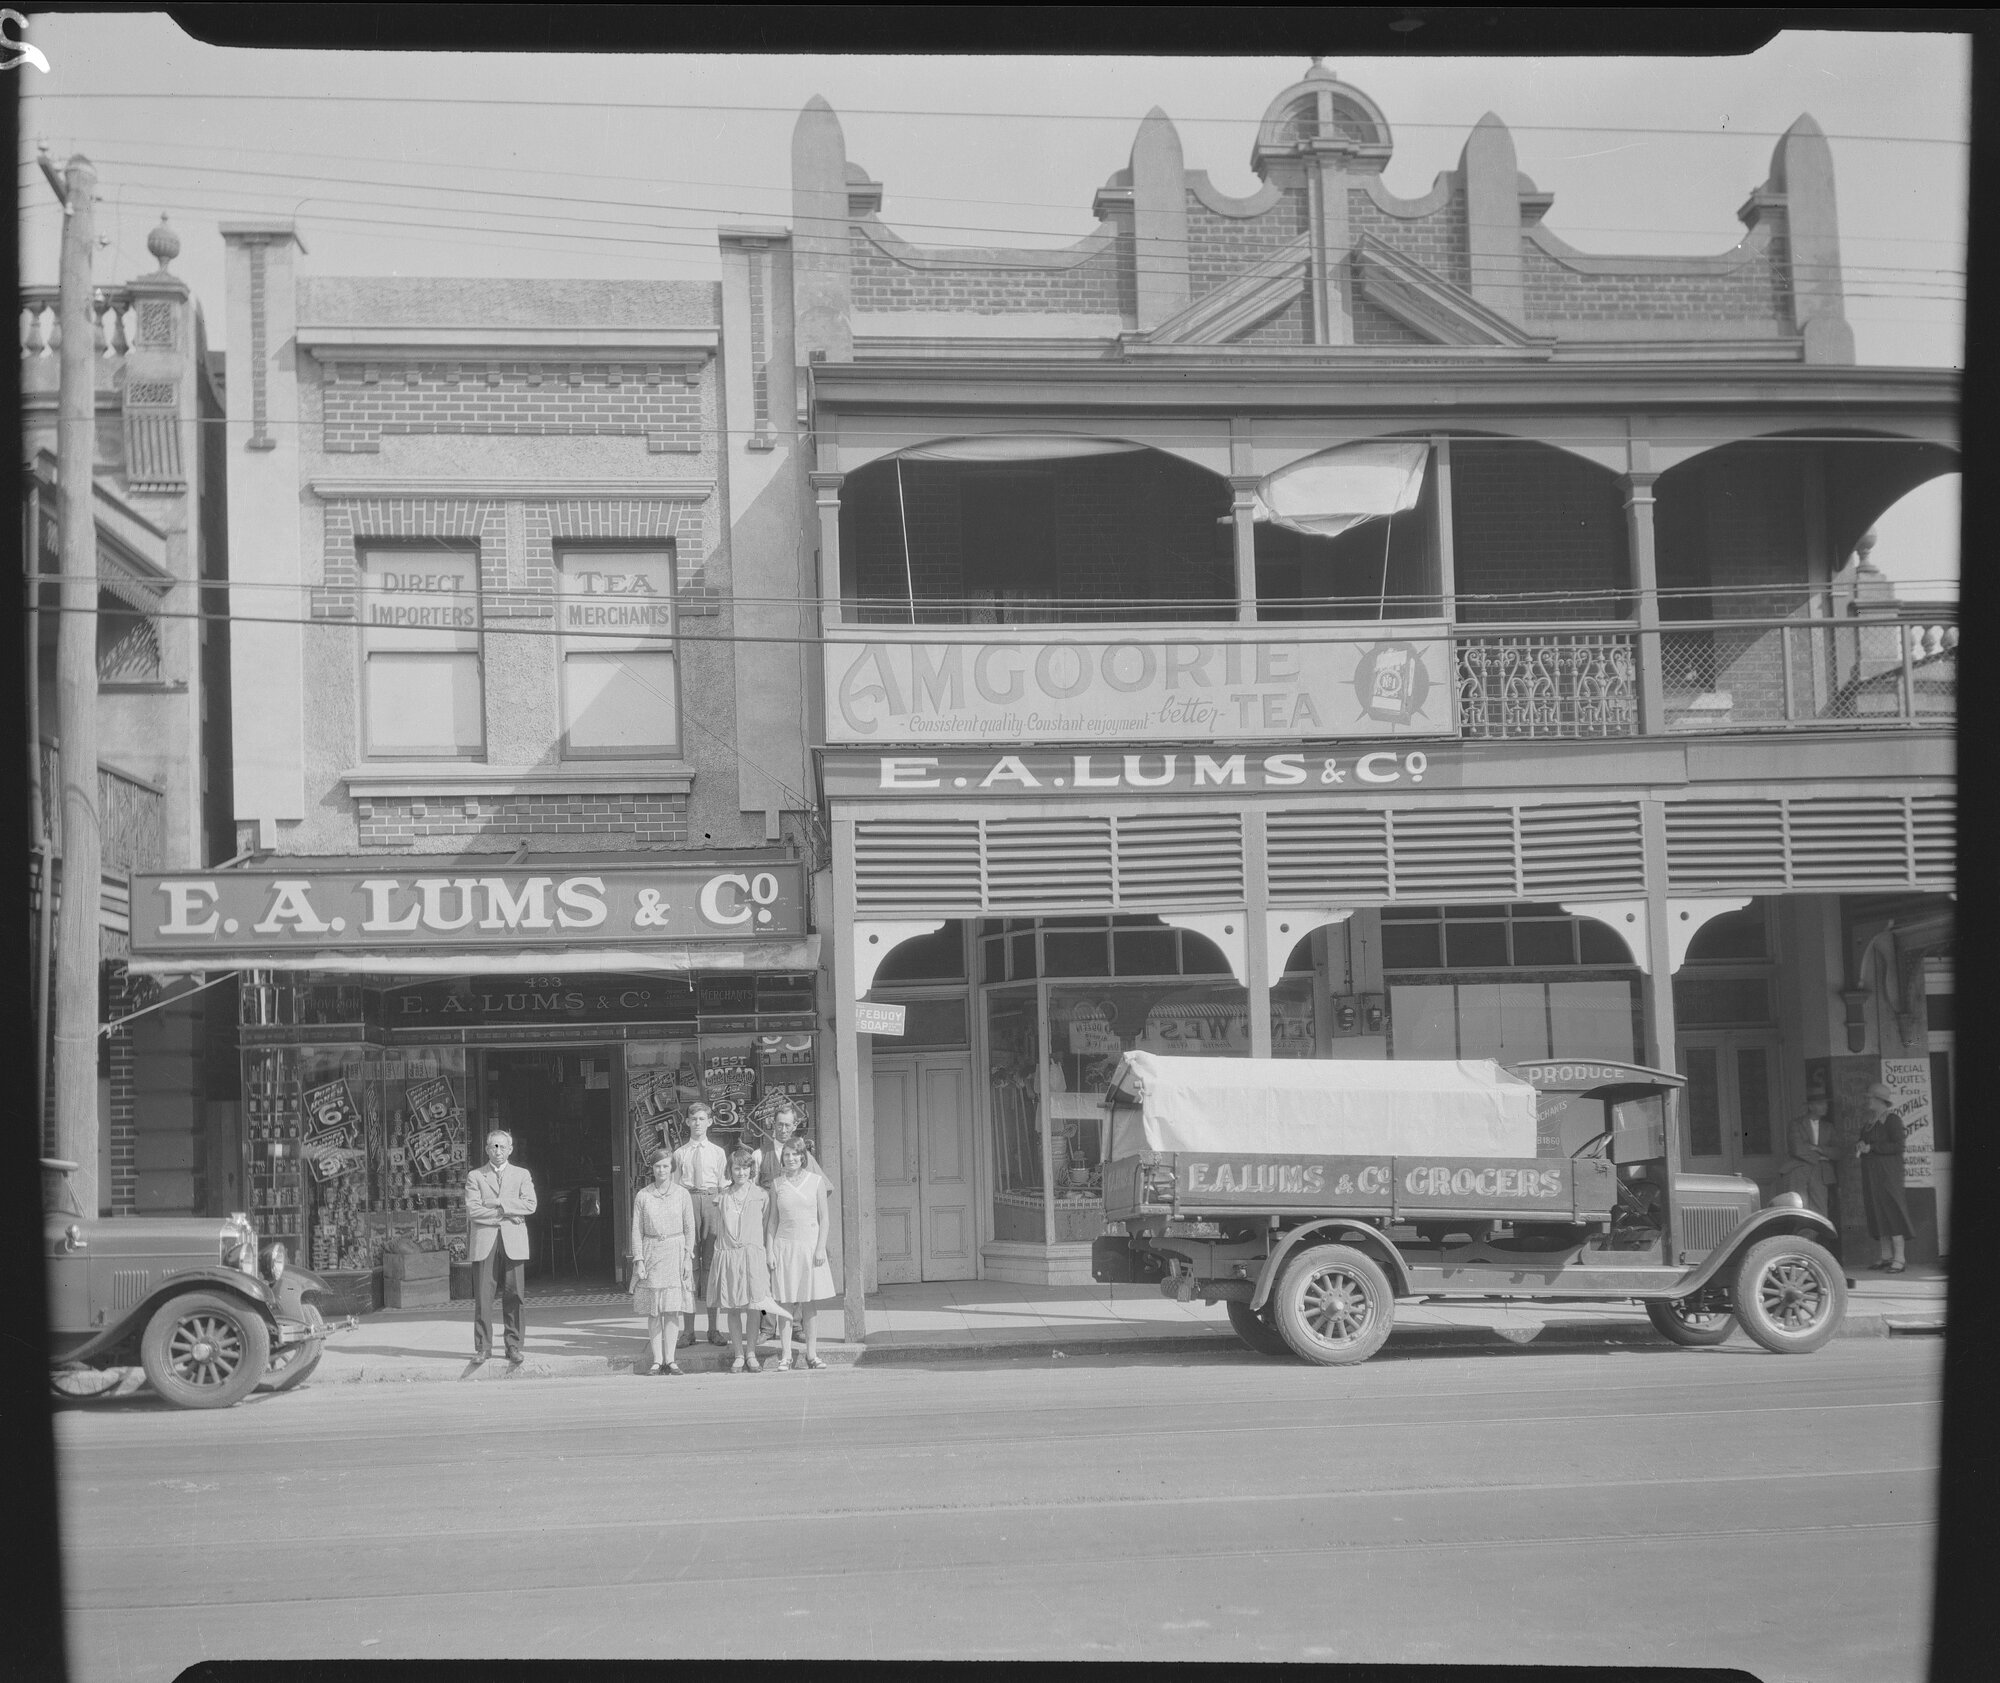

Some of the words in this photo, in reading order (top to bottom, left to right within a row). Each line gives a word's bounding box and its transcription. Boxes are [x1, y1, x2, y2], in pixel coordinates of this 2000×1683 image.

[382, 571, 465, 593] DIRECT
[575, 570, 658, 595] TEA
[369, 603, 475, 627] IMPORTERS
[568, 604, 670, 628] MERCHANTS
[838, 637, 1302, 734] AMGOORIE
[1230, 692, 1323, 729] TEA
[1320, 757, 1347, 785] &
[360, 876, 608, 932] LUMS
[633, 888, 671, 927] &
[525, 976, 563, 989] 433
[482, 991, 586, 1013] LUMS
[597, 995, 611, 1010] &
[699, 987, 755, 1003] MERCHANTS
[855, 1007, 902, 1022] IFEBUOY
[860, 1019, 889, 1032] SOAP
[711, 1055, 747, 1068] BEST
[1884, 1060, 1926, 1075] SPECIAL
[704, 1067, 756, 1087] BREAD
[1528, 1065, 1625, 1085] PRODUCE
[1885, 1074, 1928, 1088] QUOTES
[310, 1086, 344, 1112] HONEY
[313, 1083, 338, 1101] PURE
[1903, 1114, 1930, 1139] OTELS
[1903, 1155, 1932, 1166] ARDING
[1334, 1173, 1355, 1196] &
[1405, 1166, 1563, 1199] GROCERS
[1903, 1166, 1933, 1178] OUSES
